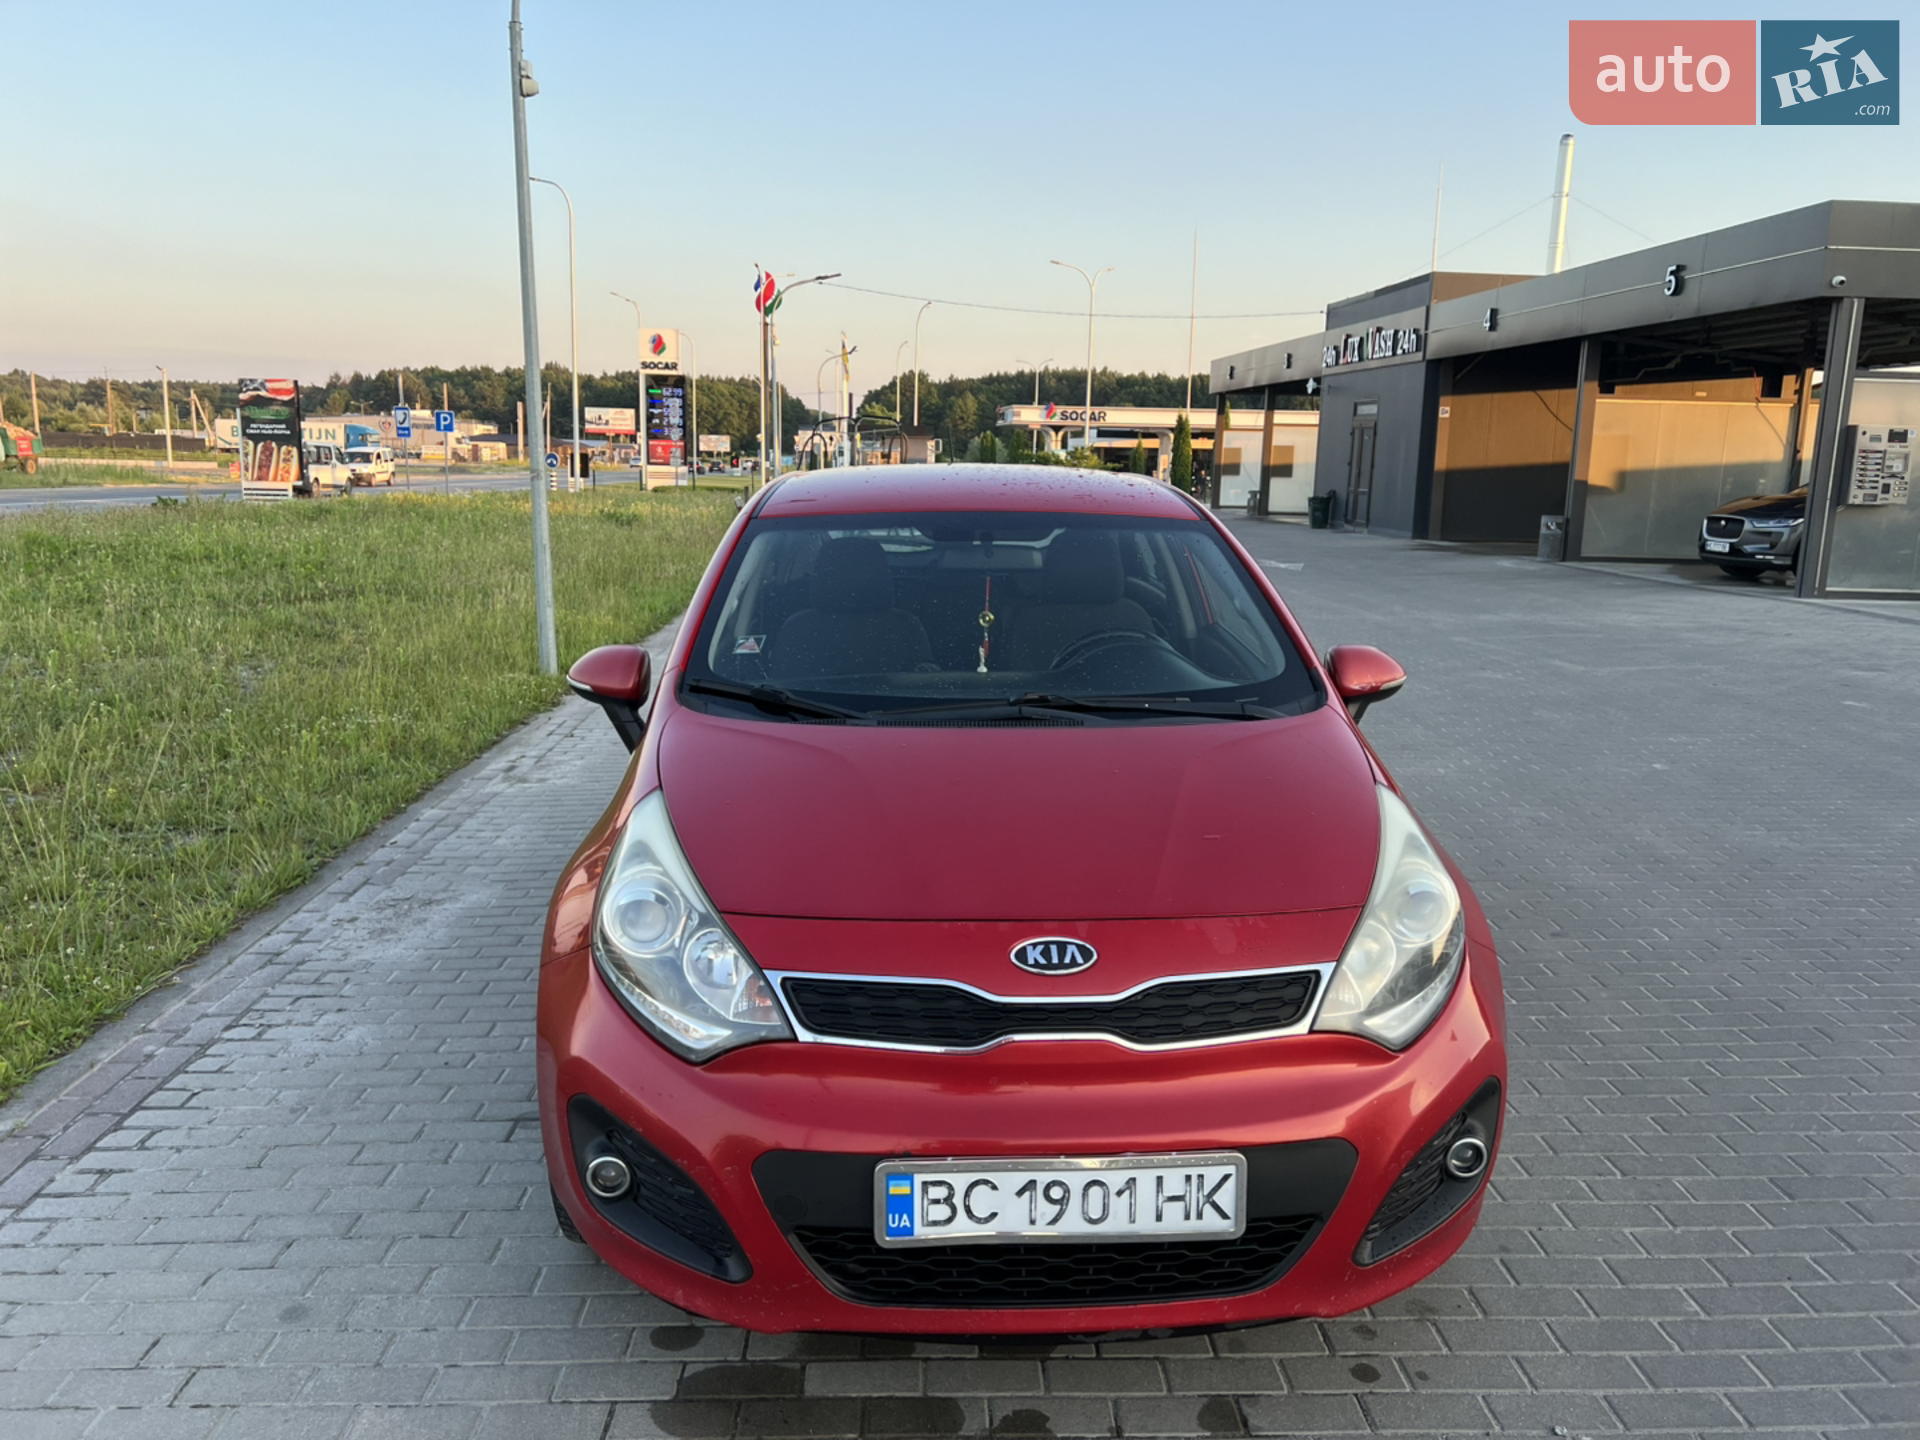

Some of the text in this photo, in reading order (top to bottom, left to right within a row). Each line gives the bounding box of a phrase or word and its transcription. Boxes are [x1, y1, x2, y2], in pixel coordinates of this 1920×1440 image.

[1664, 264, 1681, 296] 5
[1483, 308, 1493, 332] 4
[1322, 345, 1339, 368] 24h
[1364, 326, 1395, 360] WASH
[1397, 328, 1419, 355] 24h
[641, 361, 678, 370] SOCAR
[440, 413, 451, 430] P
[1060, 409, 1107, 422] SOCAR
[1026, 944, 1084, 964] KIA
[920, 1172, 1234, 1227] BC 1901 HK
[888, 1214, 911, 1228] UA
